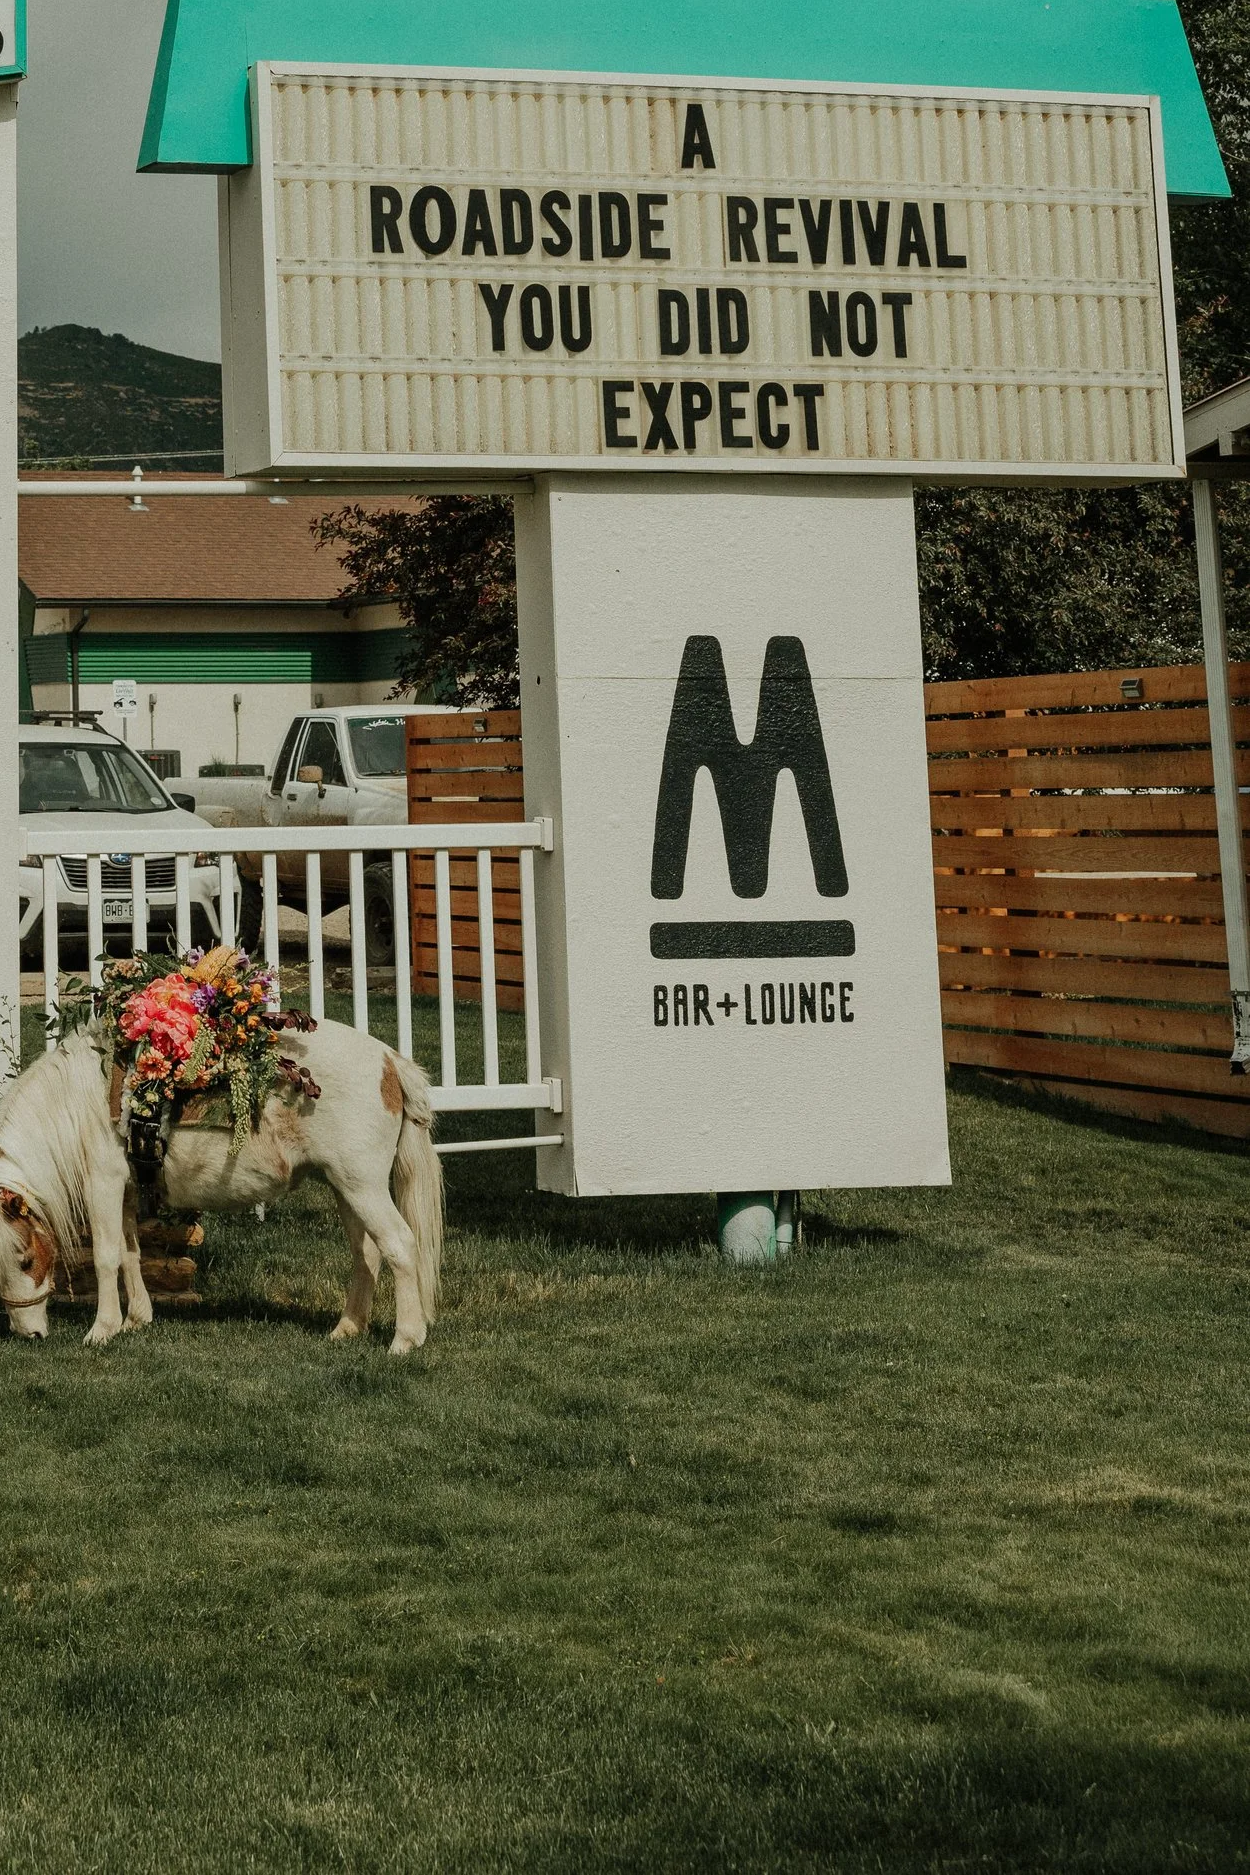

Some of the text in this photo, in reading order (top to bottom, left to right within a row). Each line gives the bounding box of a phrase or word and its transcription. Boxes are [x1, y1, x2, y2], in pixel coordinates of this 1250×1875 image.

[680, 103, 716, 169] A
[370, 185, 967, 268] ROADSIDE REVIVAL
[478, 283, 912, 358] YOU DID NOT
[602, 380, 824, 450] EXPECT
